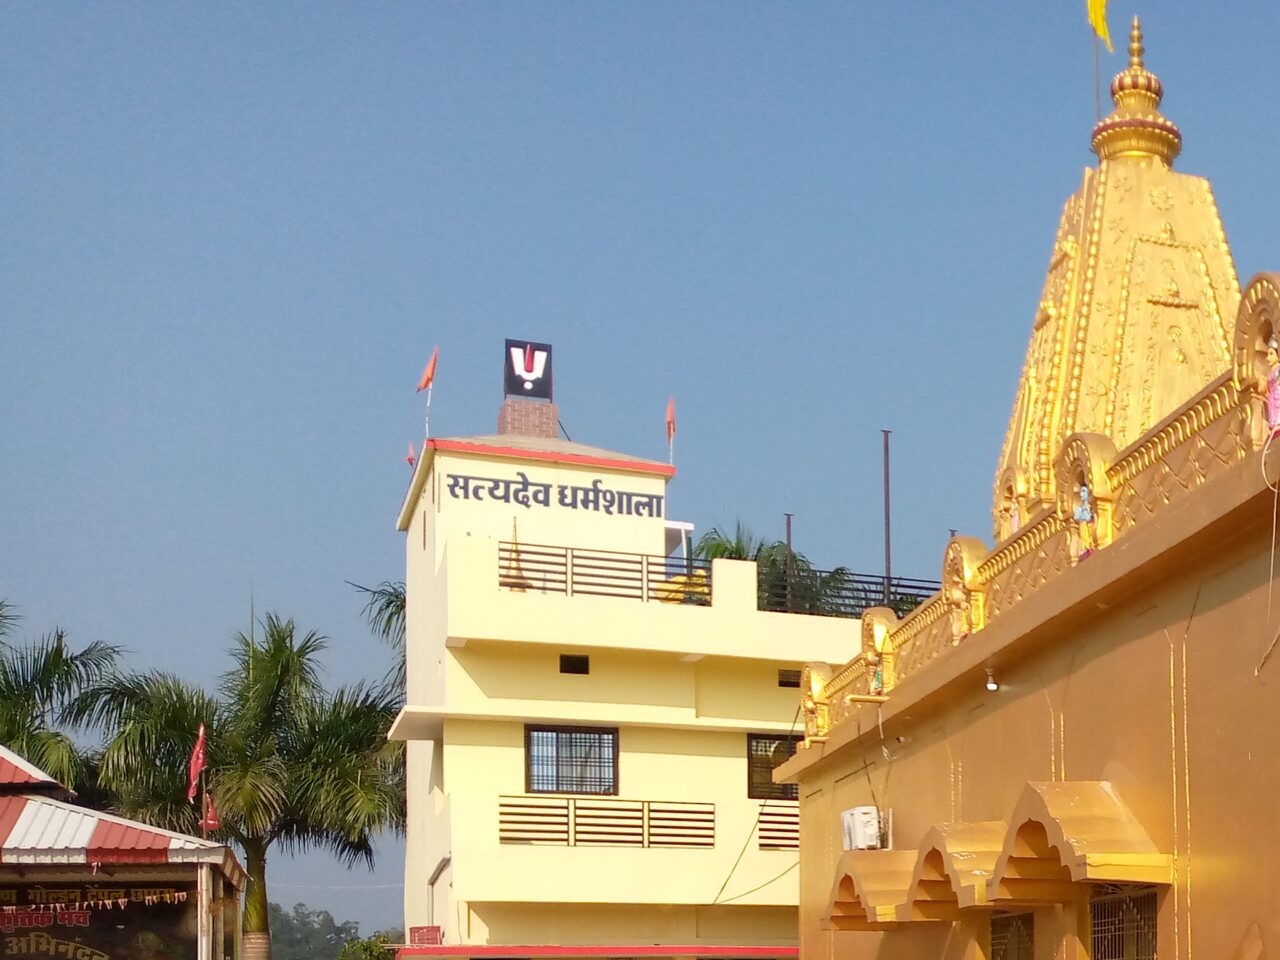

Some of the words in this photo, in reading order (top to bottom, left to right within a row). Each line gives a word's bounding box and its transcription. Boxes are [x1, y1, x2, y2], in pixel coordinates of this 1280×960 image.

[446, 472, 552, 509] सत्यदेव
[558, 479, 664, 518] धर्मशाला
[28, 884, 82, 903] गोल्डन
